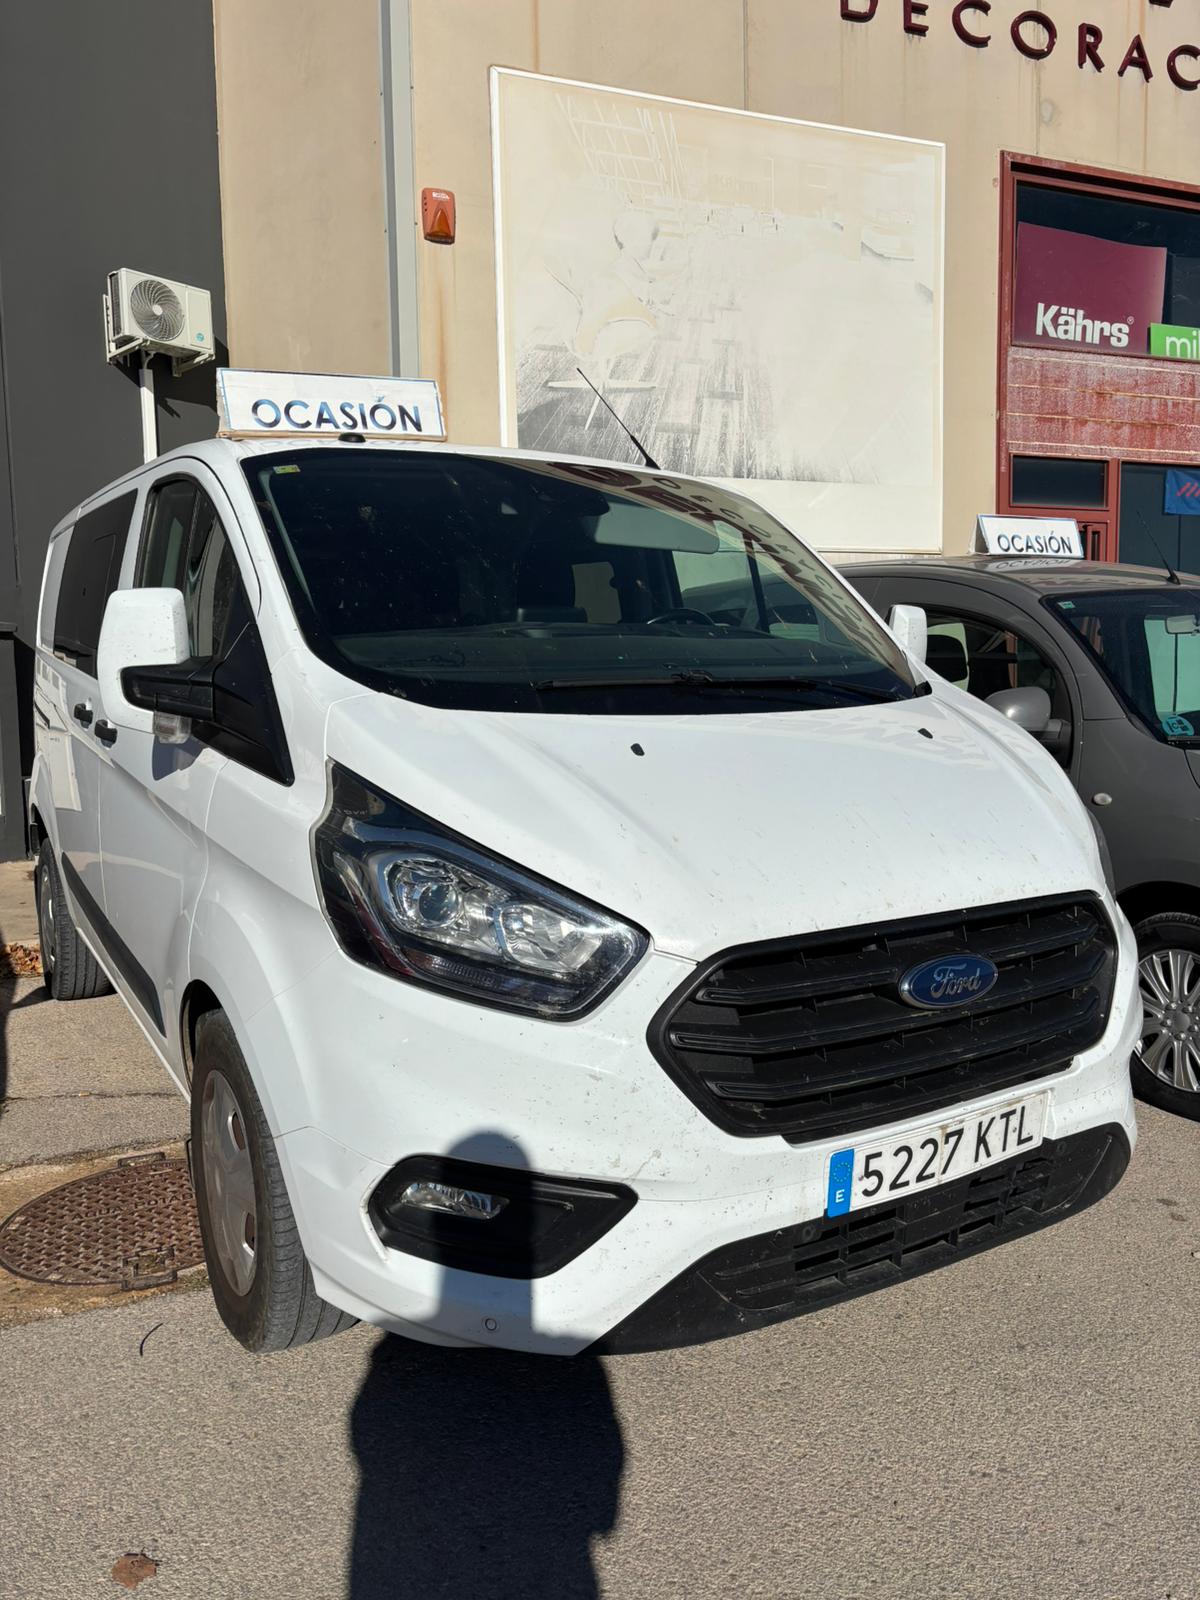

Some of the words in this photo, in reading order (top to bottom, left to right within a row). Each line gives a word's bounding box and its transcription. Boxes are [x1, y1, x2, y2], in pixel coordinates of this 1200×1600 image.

[1035, 302, 1130, 348] Kährs
[251, 393, 422, 432] OCASIÓN
[997, 530, 1073, 554] OCASIÓN
[930, 963, 982, 998] Ford
[861, 1127, 965, 1198] 5227
[973, 1105, 1034, 1163] KTL
[835, 1189, 845, 1203] E
